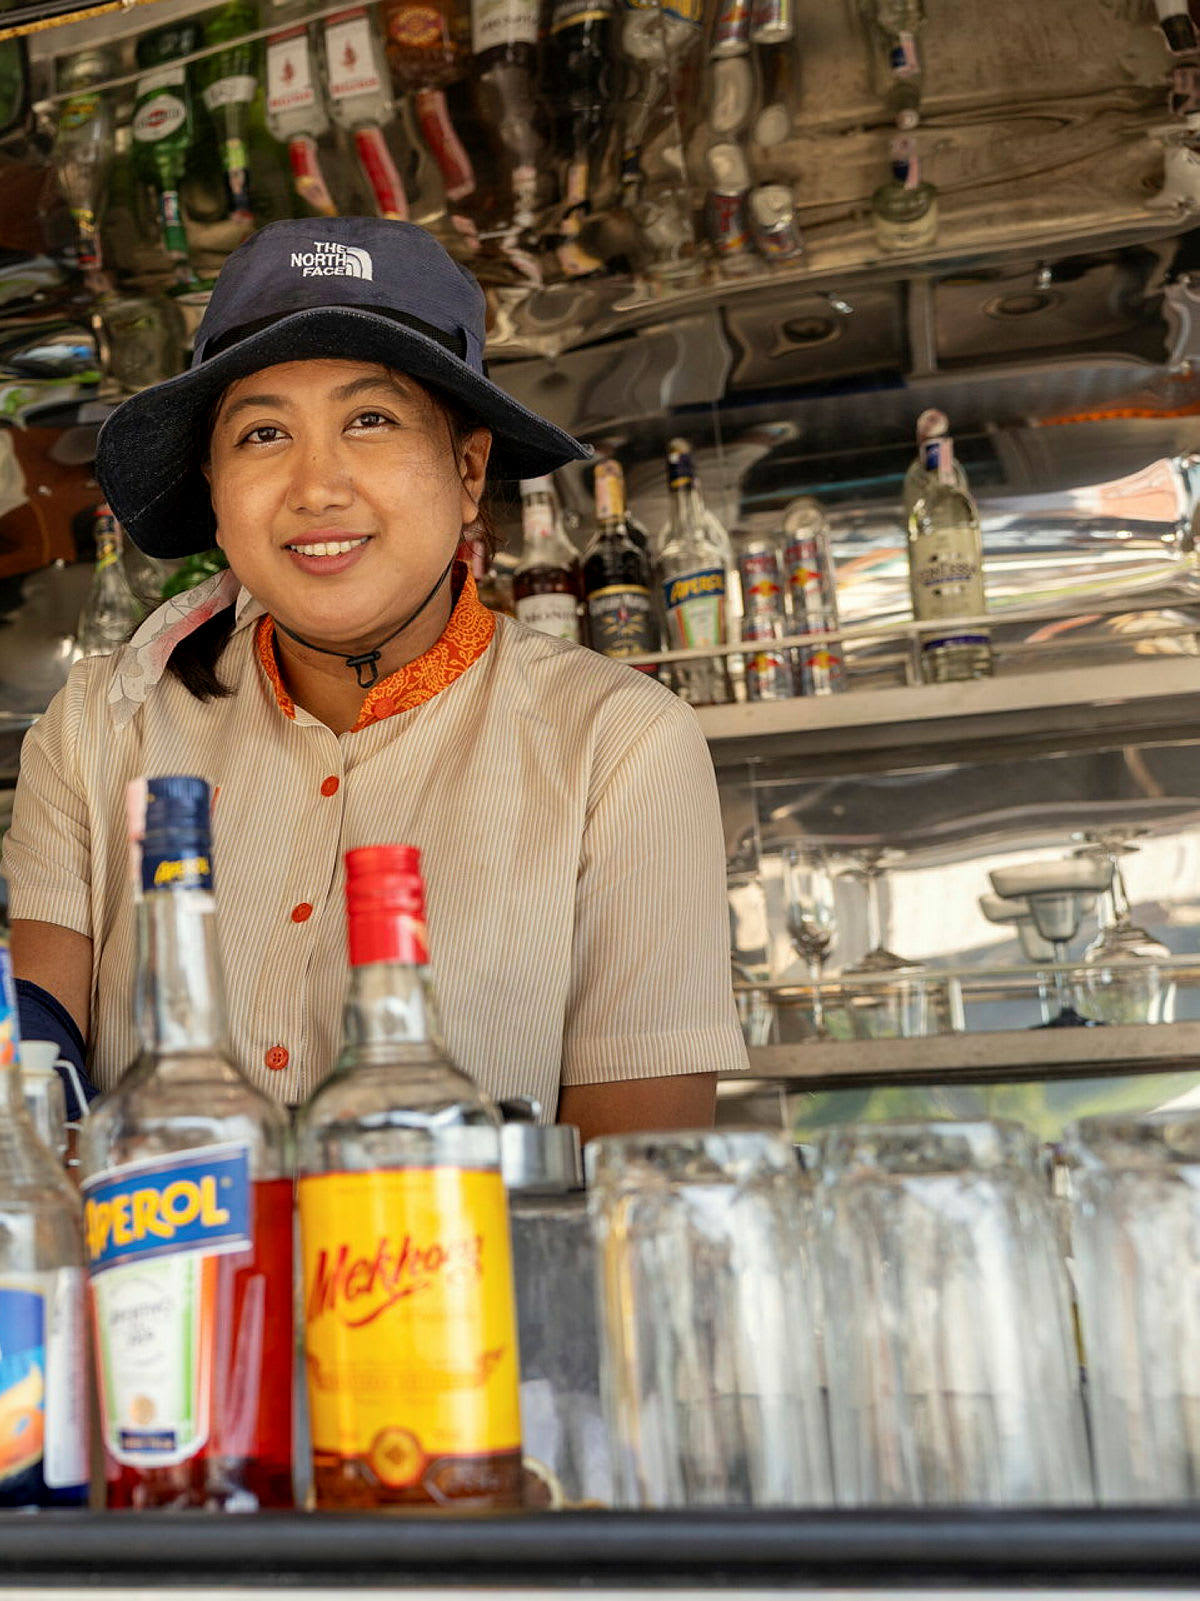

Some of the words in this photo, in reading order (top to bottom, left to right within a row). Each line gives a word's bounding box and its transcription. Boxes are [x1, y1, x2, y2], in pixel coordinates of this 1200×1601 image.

[313, 241, 347, 254] THE
[290, 252, 347, 267] NORTH
[302, 266, 346, 278] FACE
